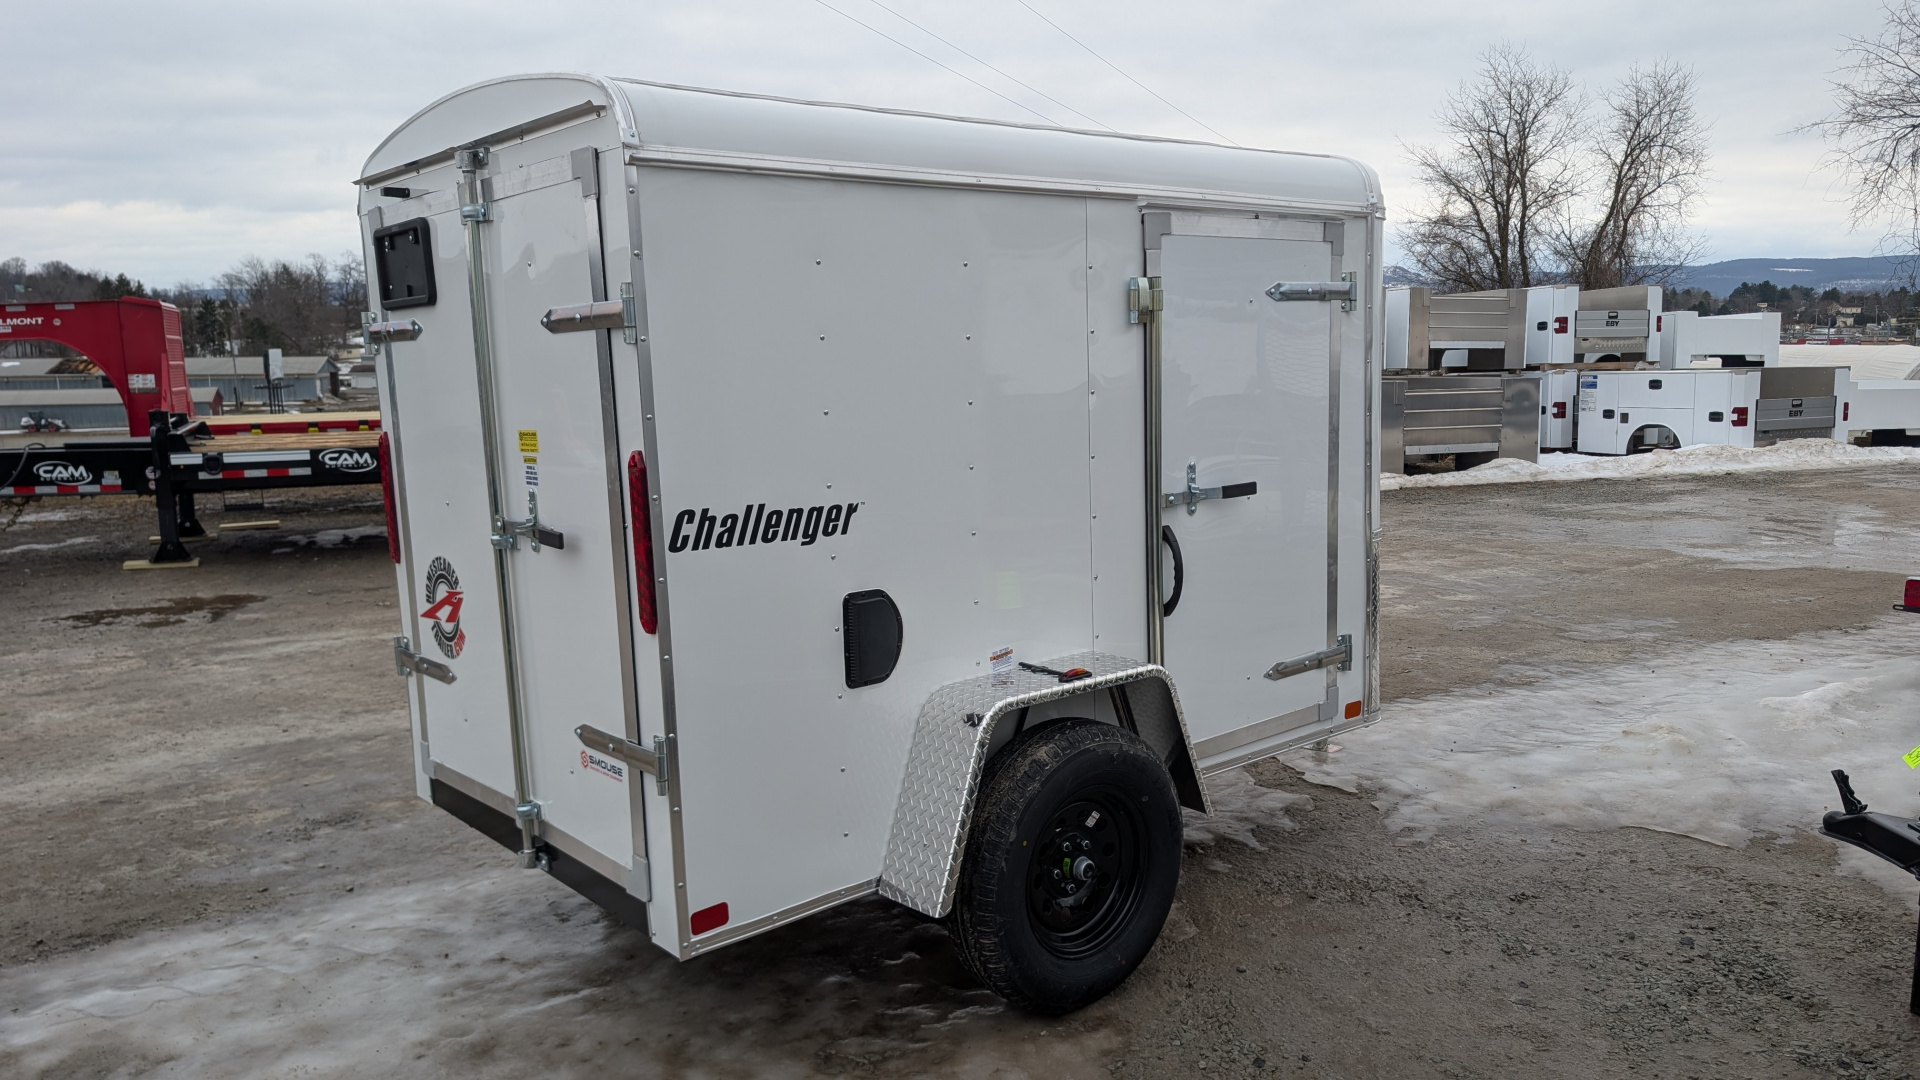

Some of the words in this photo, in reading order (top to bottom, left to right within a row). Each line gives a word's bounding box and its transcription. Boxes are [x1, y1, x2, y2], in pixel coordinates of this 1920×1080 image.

[324, 452, 373, 465] CAM
[39, 465, 88, 480] CAM
[668, 503, 859, 553] Challenger
[425, 556, 460, 605] HOMESTEADER
[588, 755, 623, 777] SMOUSE
